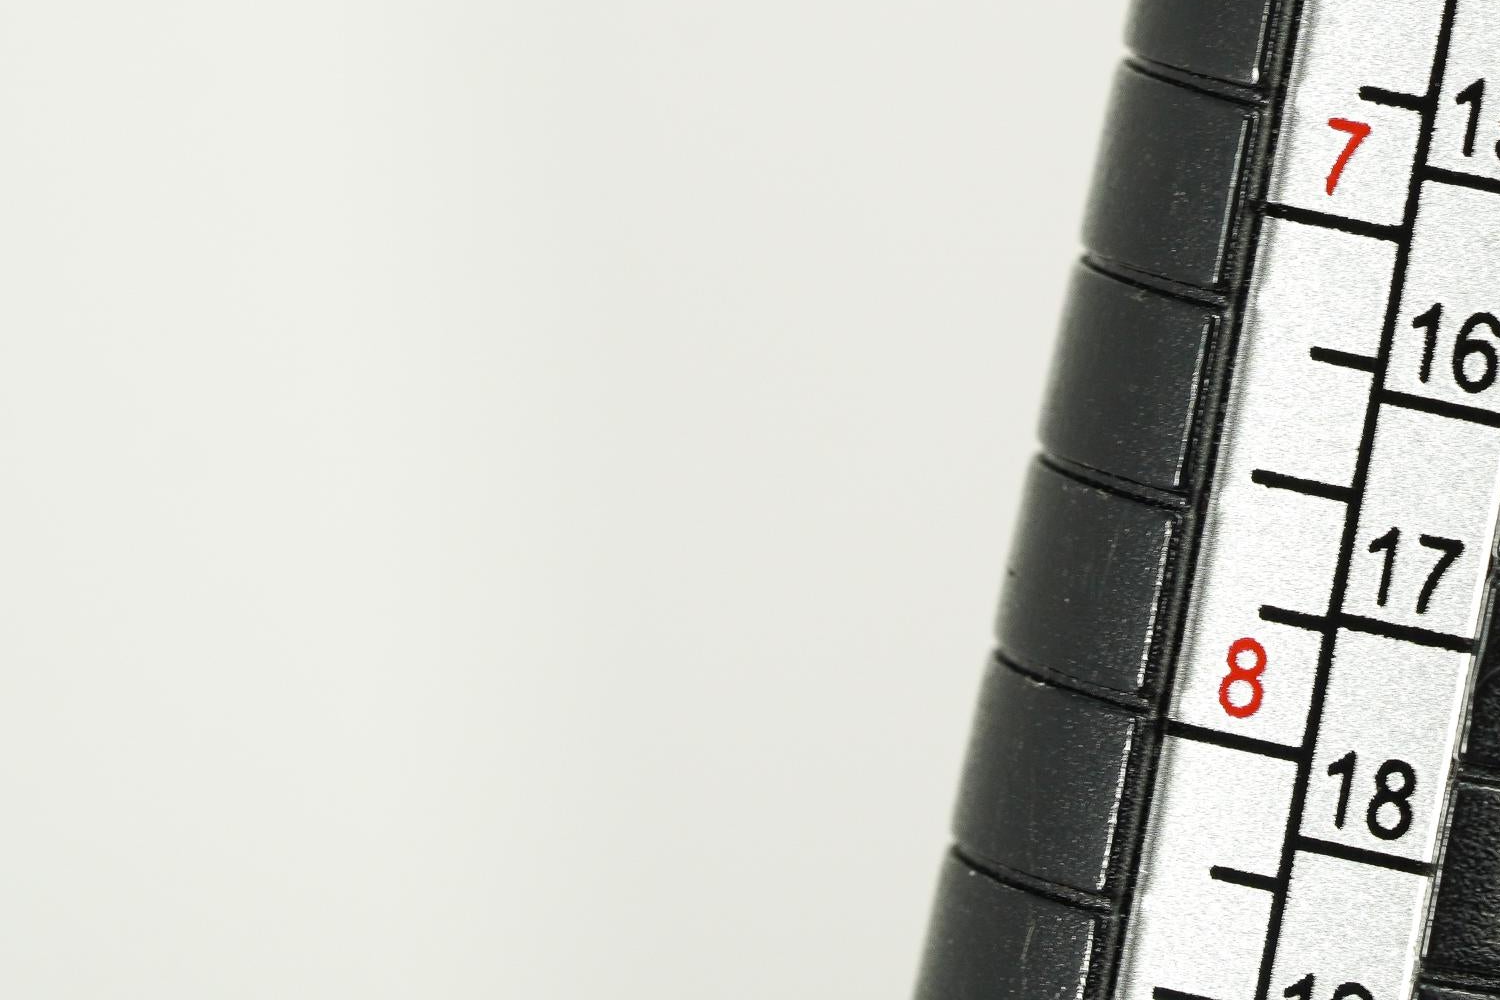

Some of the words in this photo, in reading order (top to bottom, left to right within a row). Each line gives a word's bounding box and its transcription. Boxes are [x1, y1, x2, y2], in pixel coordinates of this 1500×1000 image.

[1326, 117, 1372, 196] 7
[1368, 526, 1466, 615] 17
[1218, 637, 1267, 719] 8
[1326, 750, 1418, 841] 18
